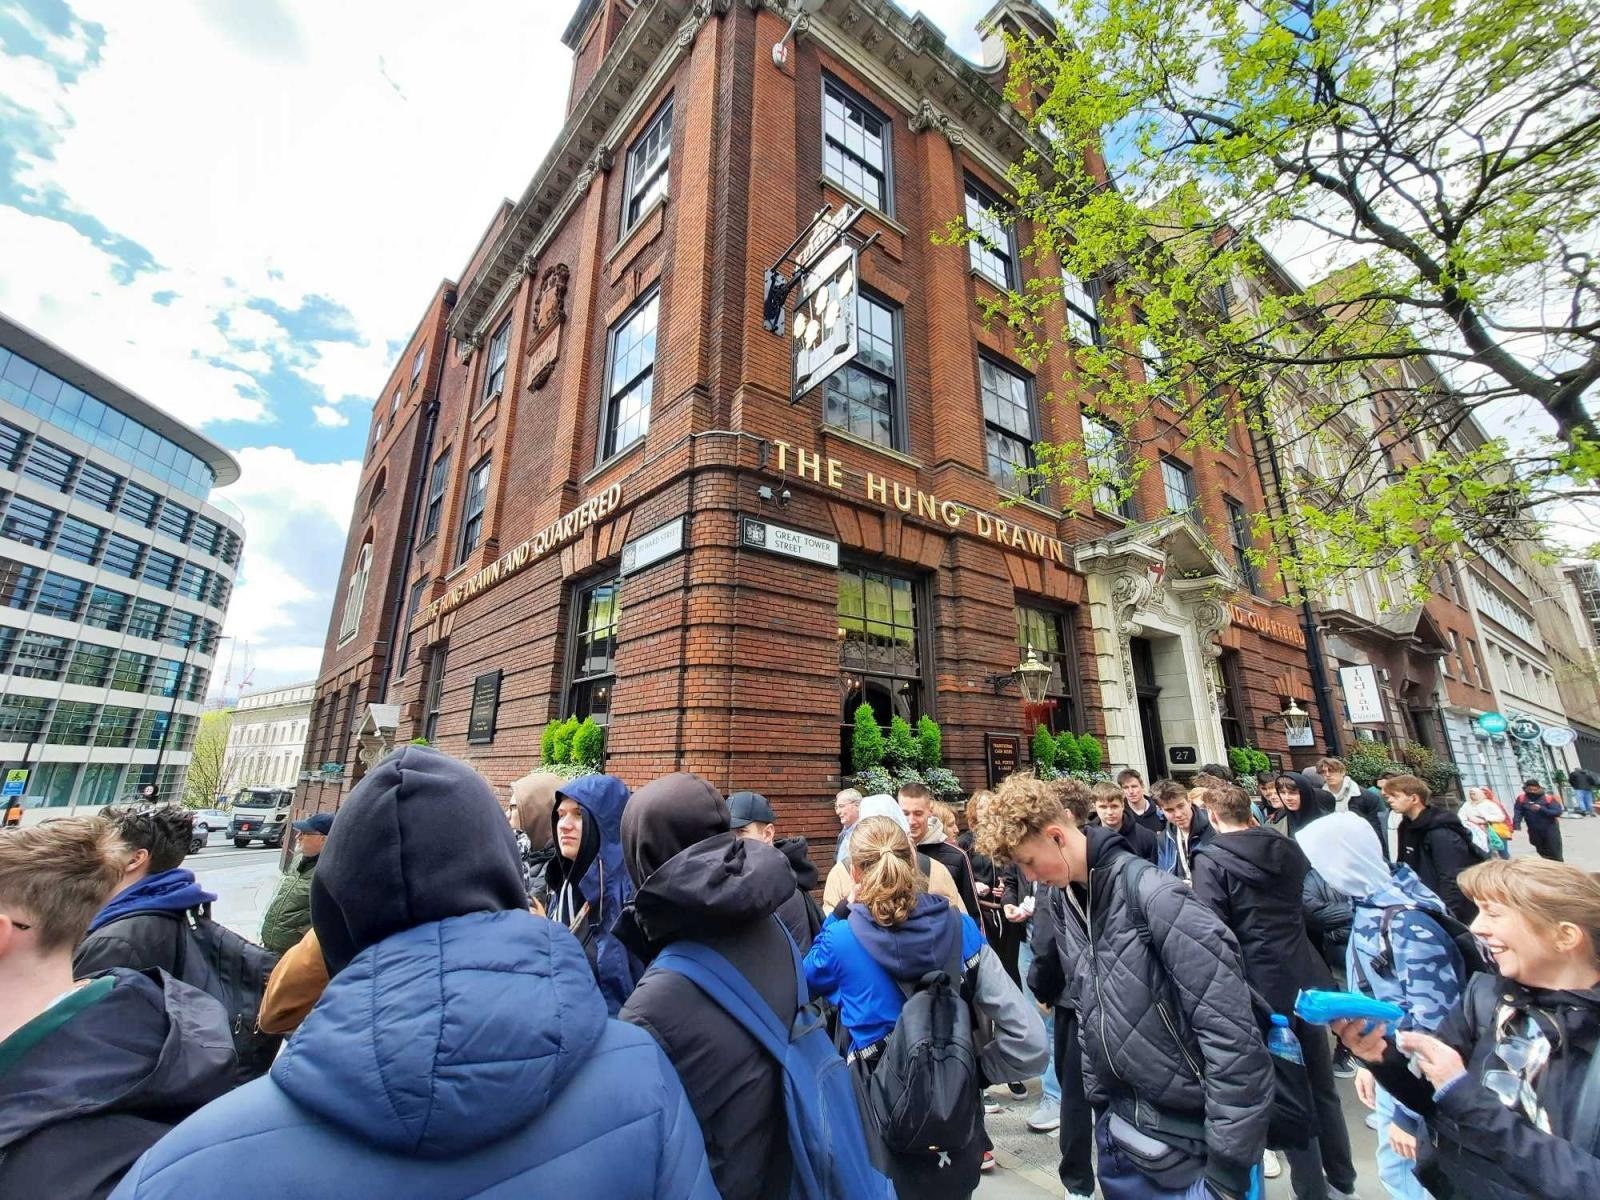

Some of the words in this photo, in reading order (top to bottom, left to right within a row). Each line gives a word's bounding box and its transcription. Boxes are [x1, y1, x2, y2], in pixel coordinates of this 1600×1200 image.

[774, 440, 842, 489] THE
[867, 472, 961, 527] HUNG
[976, 512, 1063, 563] DRAWN
[427, 600, 440, 620] THE
[440, 584, 463, 613] HUNG
[463, 558, 500, 601] DRAWN
[503, 541, 530, 578] AND
[534, 482, 622, 555] QUARTERED
[775, 530, 801, 543] GREAT
[804, 537, 831, 551] TOWER
[775, 541, 802, 553] STREET
[1248, 611, 1305, 647] QUARTERED
[1175, 751, 1189, 760] 27
